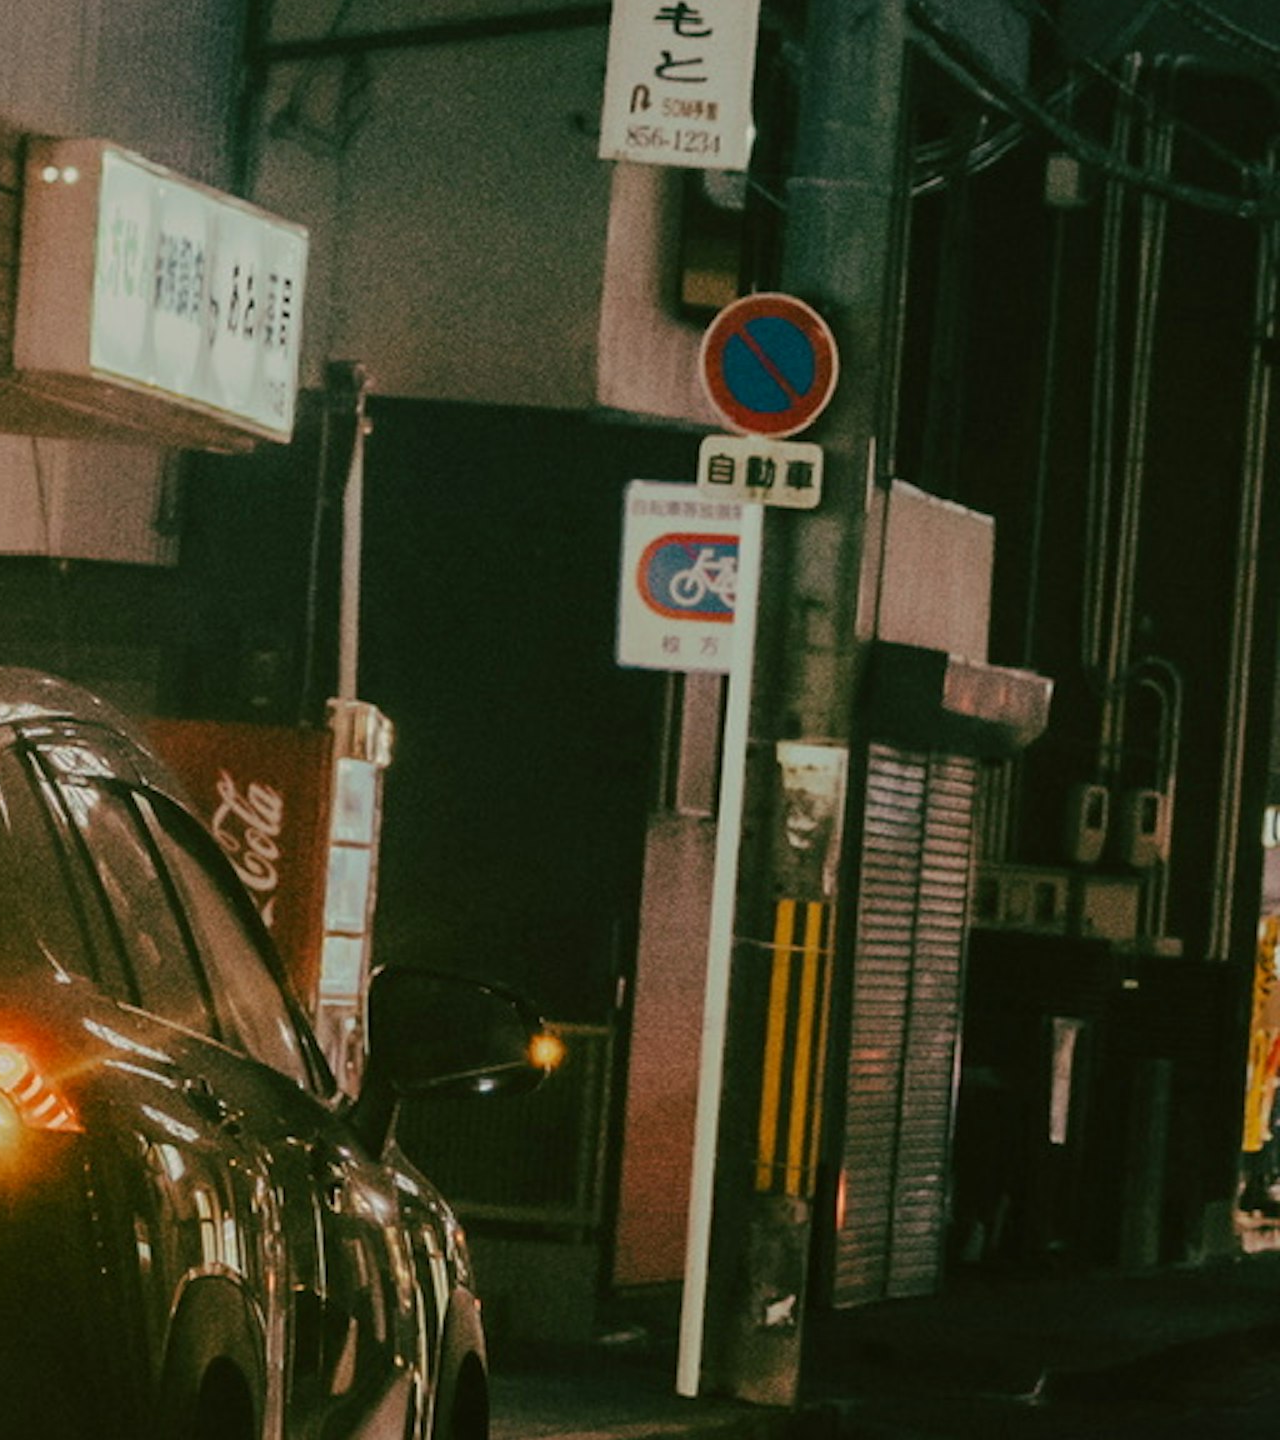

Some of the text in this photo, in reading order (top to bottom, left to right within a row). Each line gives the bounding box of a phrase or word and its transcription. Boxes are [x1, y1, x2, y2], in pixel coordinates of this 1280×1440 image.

[625, 126, 722, 157] 856-1234
[707, 452, 814, 492] 自動車
